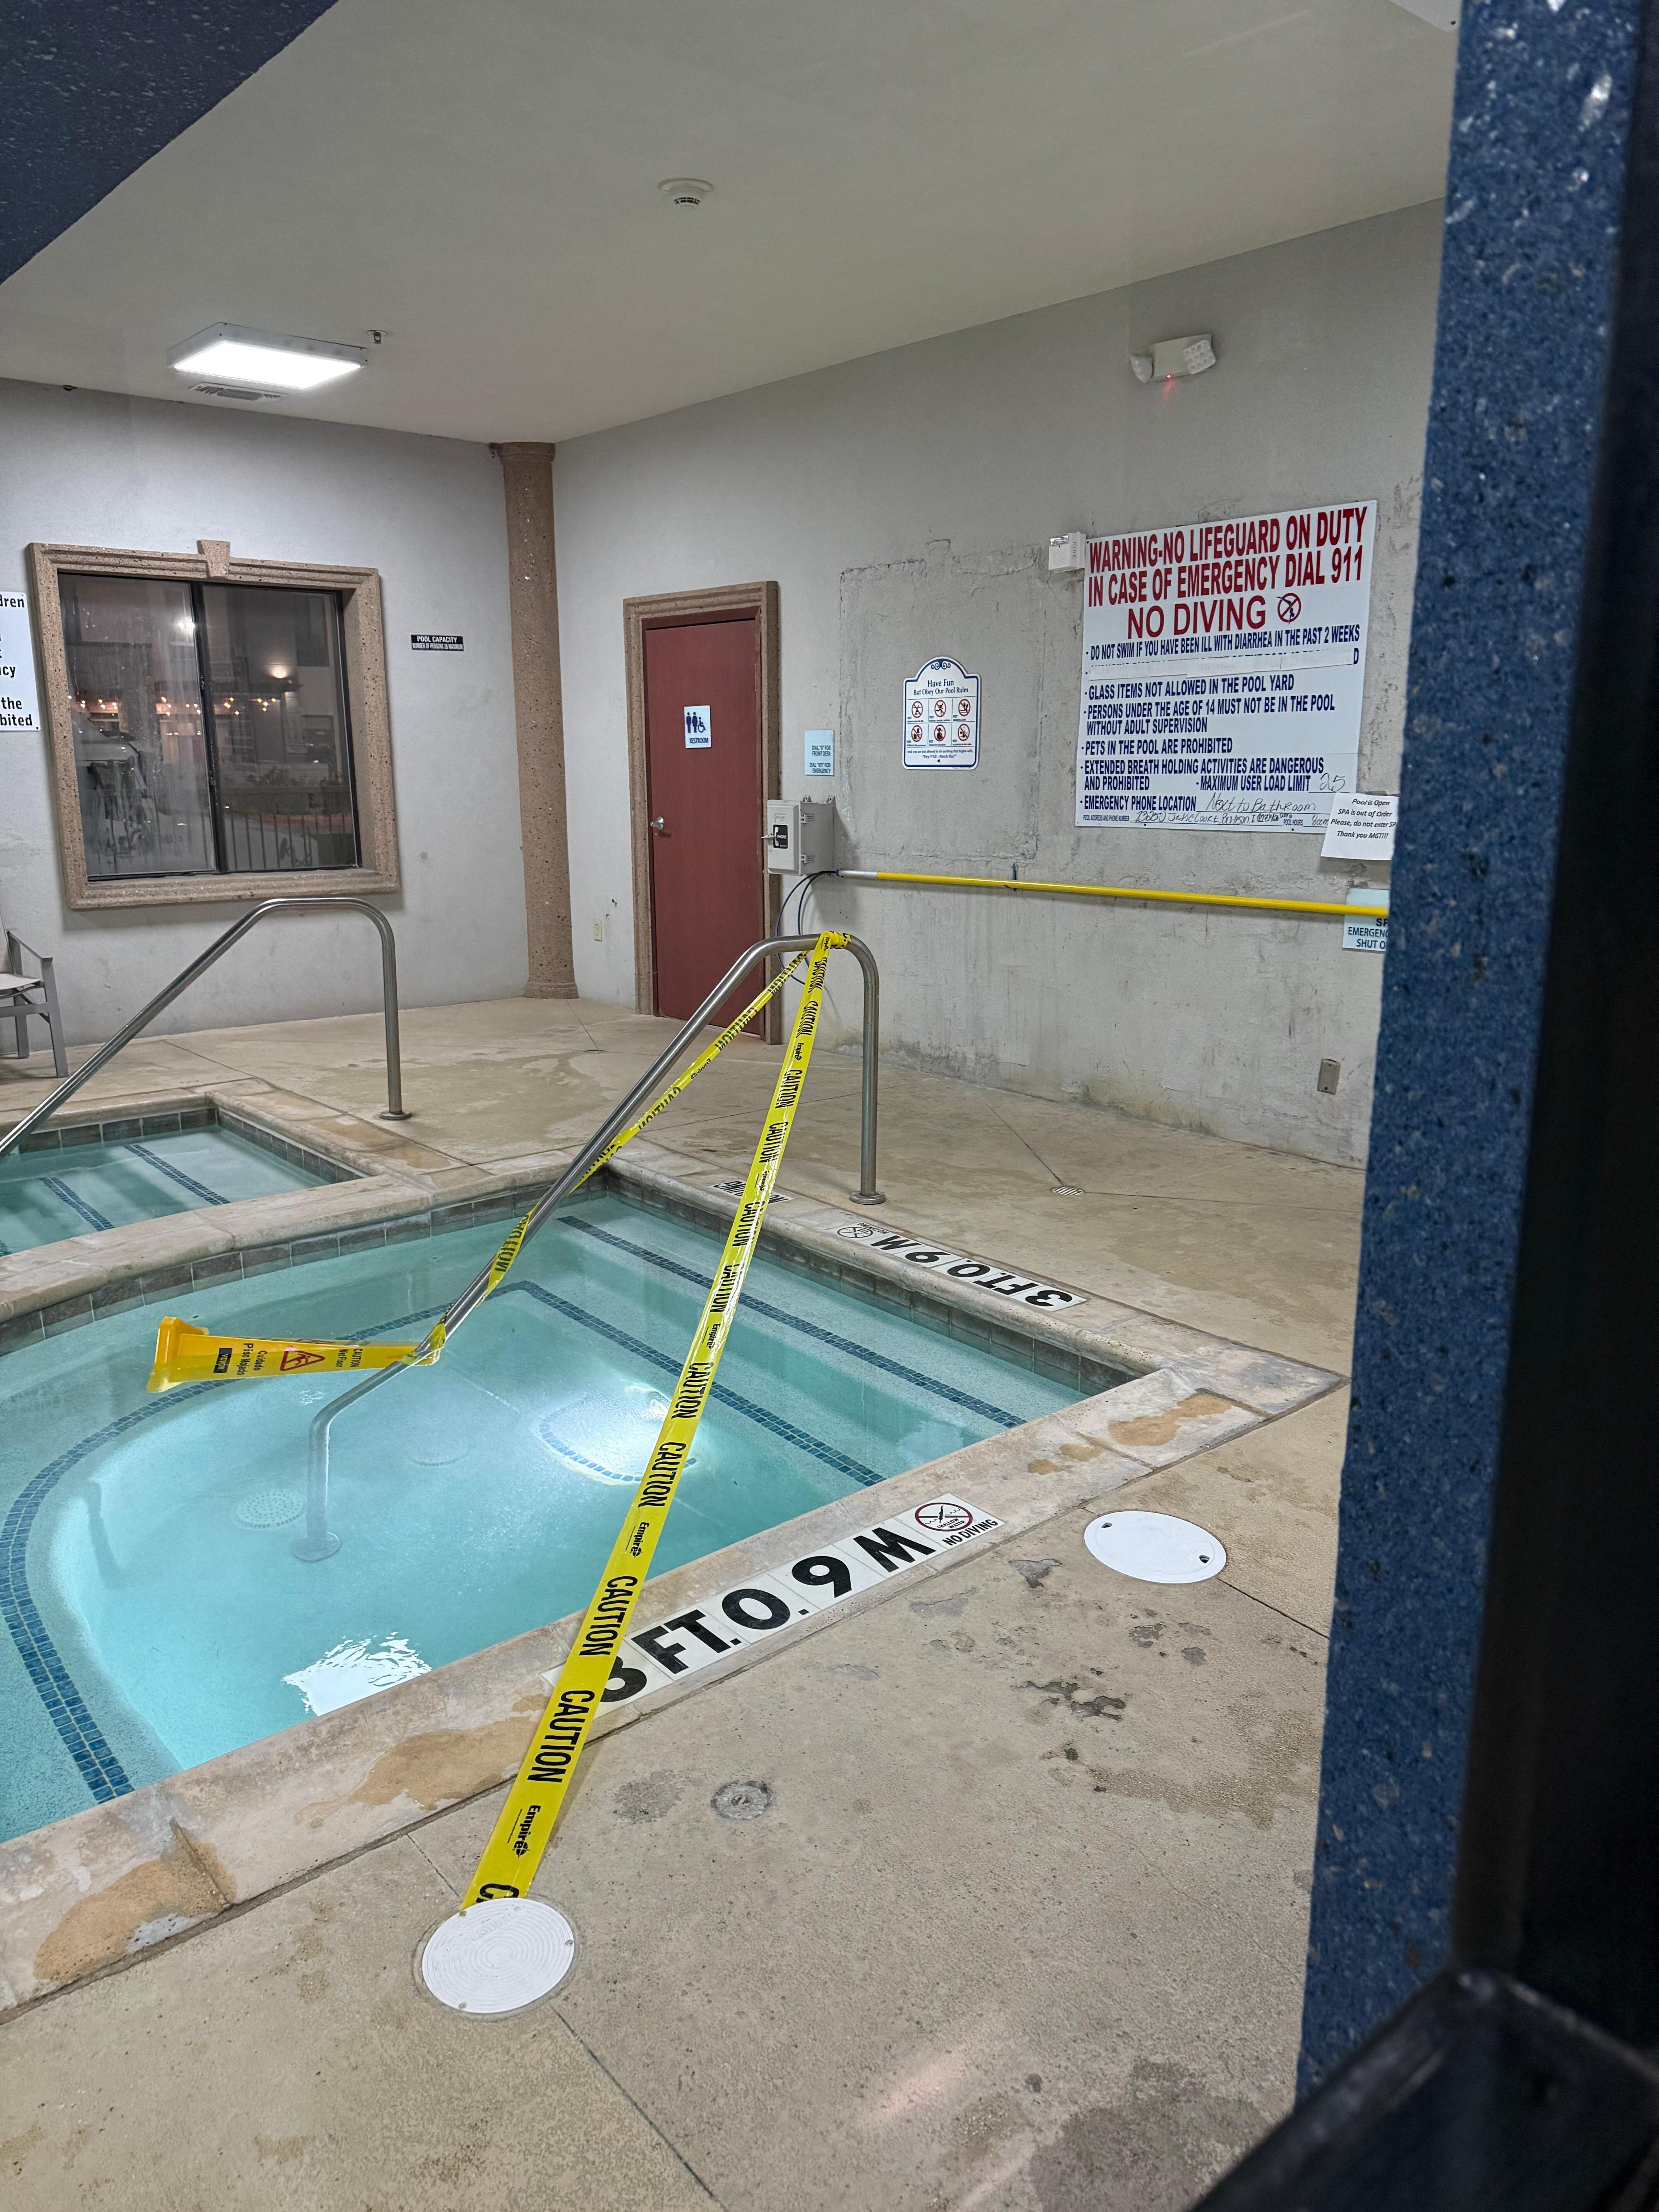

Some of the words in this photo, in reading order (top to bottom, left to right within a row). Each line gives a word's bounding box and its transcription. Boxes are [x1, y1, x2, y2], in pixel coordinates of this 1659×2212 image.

[1190, 518, 1280, 562] LIFEGUARD
[1286, 514, 1310, 550] ON
[1317, 507, 1367, 547] DUTY
[1089, 575, 1103, 607] IN
[1108, 570, 1147, 605] CASE
[1152, 568, 1172, 601] OF
[1177, 555, 1280, 598] EMERGENCY
[1285, 550, 1325, 587] DIAL
[1331, 545, 1362, 583] 911
[1128, 606, 1164, 639] NO
[1174, 595, 1266, 635] DIVING
[1091, 645, 1099, 660] DO
[1101, 644, 1115, 659] NOT
[1116, 642, 1134, 658] SWIM
[1136, 641, 1142, 657] IF
[1144, 640, 1158, 656] YOU
[1160, 639, 1178, 655] HAVE
[1181, 637, 1199, 654] BEEN
[1201, 636, 1212, 652] ILL
[1214, 634, 1232, 651] WITH
[1235, 631, 1273, 650] DIARRHEA
[1274, 630, 1283, 647] IN
[1285, 629, 1300, 646] THE
[1302, 627, 1322, 645] PAST
[1324, 626, 1329, 643] 2
[1331, 624, 1360, 643] WEEKS
[1089, 684, 1115, 700] GLASS
[1117, 683, 1142, 699] ITEMS
[1145, 682, 1163, 697] NOT
[1165, 679, 1206, 696] ALLOWED
[1209, 678, 1219, 694] IN
[1221, 677, 1239, 694] THE
[1242, 675, 1266, 692] POOL
[1270, 674, 1294, 691] YARD
[0, 697, 22, 709] the
[1088, 703, 1123, 719] PERSONS
[1125, 702, 1152, 718] UNDER
[1155, 701, 1171, 717] THE
[1173, 700, 1190, 716] AGE
[1192, 699, 1203, 715] OF
[1206, 699, 1215, 715] 14
[1218, 698, 1241, 714] MUST
[1243, 697, 1262, 713] NOT
[1264, 696, 1276, 713] BE
[1278, 696, 1288, 713] IN
[1290, 695, 1308, 712] THE
[1310, 694, 1335, 711] POOL
[1087, 720, 1123, 735] WITHOUT
[1124, 719, 1150, 735] ADULT
[1152, 717, 1207, 734] SUPERVISION
[1085, 740, 1105, 755] PETS
[1107, 740, 1116, 755] IN
[1118, 740, 1134, 755] THE
[1137, 739, 1159, 754] POOL
[1161, 739, 1178, 754] ARE
[1181, 738, 1233, 754] PROHIBITED
[1085, 760, 1125, 775] EXTENDED
[1128, 759, 1159, 774] BREATH
[1161, 759, 1198, 774] HOLDING
[1201, 758, 1247, 774] ACTIVITIES
[1249, 757, 1267, 774] ARE
[1269, 757, 1324, 774] DANGEROUS
[1084, 776, 1100, 790] AND
[1103, 776, 1149, 790] PROHIBITED
[1200, 775, 1238, 791] MAXIMUM
[1241, 775, 1262, 791] USER
[1264, 775, 1285, 791] LOAD
[1288, 775, 1311, 791] LIMIT
[1319, 773, 1346, 792] 25
[1084, 795, 1129, 810] EMERGENCY
[1131, 795, 1157, 811] PHONE
[1159, 796, 1197, 811] LOCATION
[1356, 939, 1378, 948] SHUT
[796, 1001, 818, 1038] CAUTION
[795, 1042, 804, 1060] Empire
[775, 1069, 803, 1109] CAUTION
[759, 1121, 788, 1163] CAUTION
[732, 1201, 765, 1247] CAUTION
[870, 1235, 920, 1251] M
[1025, 1290, 1073, 1307] 3
[242, 1343, 254, 1358] Piso
[253, 1350, 268, 1371] Cuidado
[350, 1348, 363, 1367] CAUTION
[236, 1358, 251, 1375] Mojado
[671, 1362, 714, 1419] CAUTION
[637, 1441, 687, 1508] CAUTION
[941, 1535, 963, 1546] NO
[958, 1519, 998, 1539] DIVING
[948, 1520, 966, 1529] WATER
[630, 1522, 650, 1555] Empire
[853, 1527, 936, 1573] M
[578, 1575, 638, 1656] CAUTION
[527, 1689, 596, 1784] CAUTION
[514, 1805, 541, 1849] Empire
